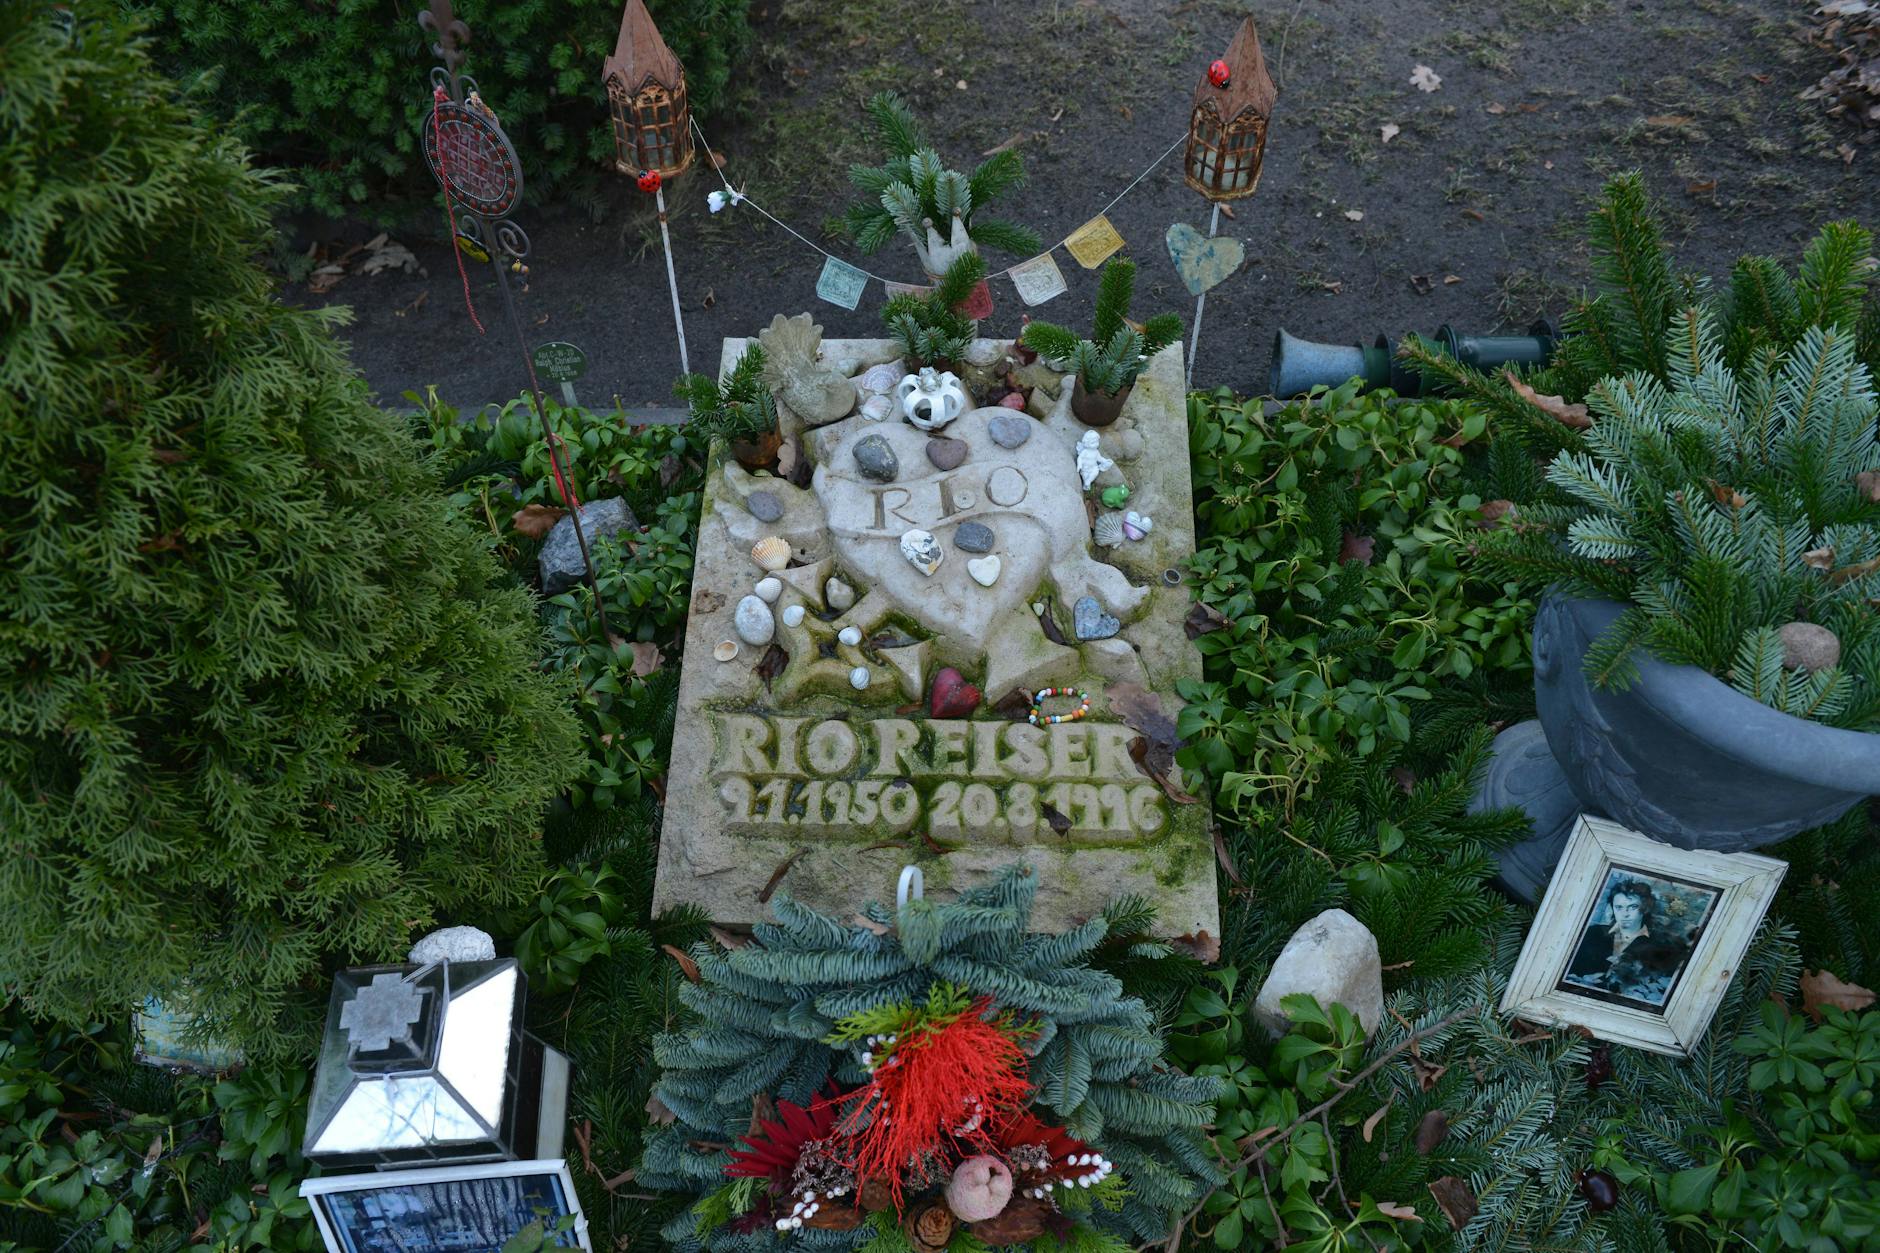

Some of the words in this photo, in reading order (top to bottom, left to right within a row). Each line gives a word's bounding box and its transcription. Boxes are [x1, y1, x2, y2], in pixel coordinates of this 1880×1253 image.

[865, 466, 1028, 531] RIO
[714, 714, 857, 775] RIO
[866, 717, 1154, 781] REISER
[720, 776, 919, 828] 9.1.1950
[929, 780, 1167, 833] 20.8.1996
